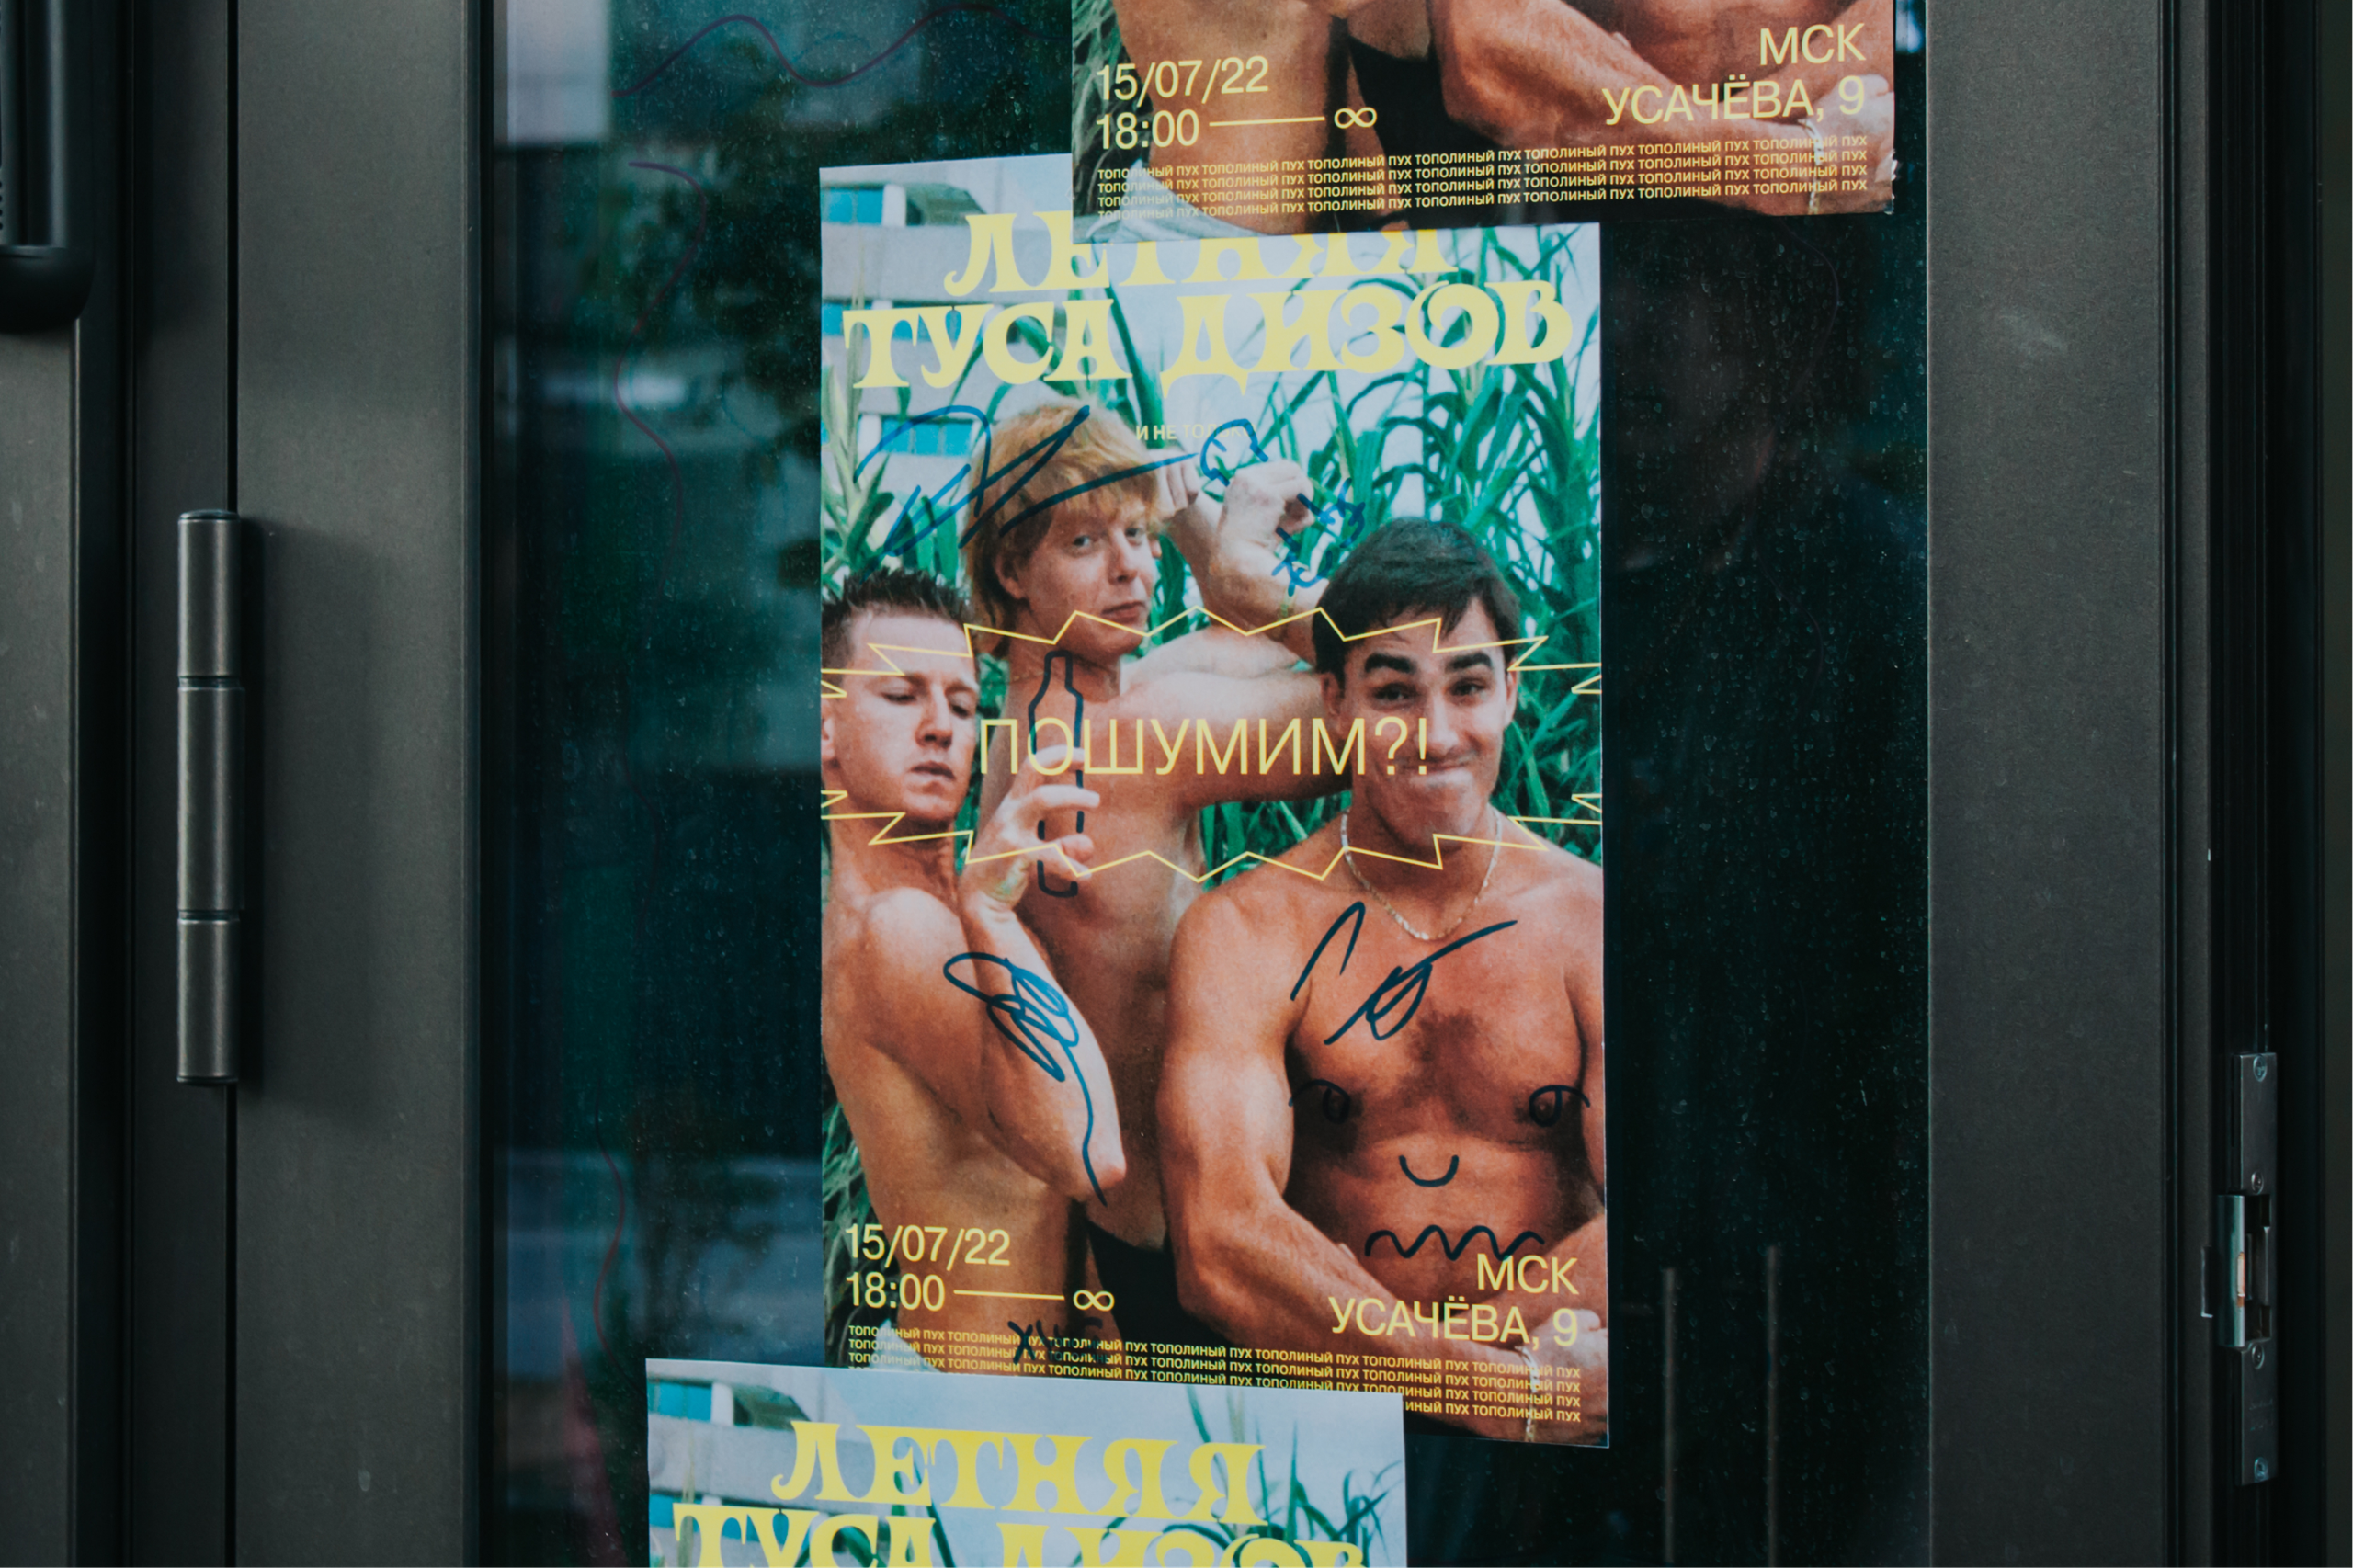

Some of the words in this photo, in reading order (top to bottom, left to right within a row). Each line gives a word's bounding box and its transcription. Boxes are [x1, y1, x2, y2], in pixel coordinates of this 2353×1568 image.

[1759, 22, 1867, 68] МСК
[1097, 56, 1269, 107] 15/07/22
[1600, 74, 1824, 126] УСАЧЁВА,
[1838, 74, 1866, 115] 9
[1097, 108, 1200, 150] 18:00
[1098, 165, 1173, 180] ТОПОЛИНЫЙ
[1176, 165, 1199, 176] ПУХ
[1202, 161, 1278, 176] ТОПОЛИНЫЙ
[1282, 160, 1304, 172] ПУХ
[1307, 156, 1384, 171] ТОПОЛИНЫЙ
[1389, 155, 1412, 167] ПУХ
[1415, 152, 1494, 166] ТОПОЛИНЫЙ
[1498, 151, 1521, 163] ПУХ
[1524, 146, 1607, 161] ТОПОЛИНЫЙ
[1610, 145, 1634, 157] ПУХ
[1638, 142, 1721, 156] ТОПОЛИНЫЙ
[1725, 141, 1749, 152] ПУХ
[1842, 135, 1867, 147] ПУХ
[1098, 179, 1173, 194] ТОПОЛИНЫЙ
[1176, 178, 1199, 190] ПУХ
[1202, 175, 1278, 189] ТОПОЛИНЫЙ
[1282, 174, 1304, 186] ПУХ
[1307, 170, 1384, 185] ТОПОЛИНЫЙ
[1389, 169, 1412, 181] ПУХ
[1415, 165, 1494, 180] ТОПОЛИНЫЙ
[1498, 165, 1521, 176] ПУХ
[1524, 161, 1607, 176] ТОПОЛИНЫЙ
[1610, 160, 1634, 172] ПУХ
[1638, 156, 1721, 170] ТОПОЛИНЫЙ
[1725, 155, 1749, 166] ПУХ
[1842, 150, 1867, 162] ПУХ
[1176, 192, 1199, 204] ПУХ
[1202, 188, 1278, 203] ТОПОЛИНЫЙ
[1282, 188, 1304, 199] ПУХ
[1307, 185, 1384, 199] ТОПОЛИНЫЙ
[1389, 184, 1412, 195] ПУХ
[1415, 180, 1494, 194] ТОПОЛИНЫЙ
[1498, 179, 1521, 190] ПУХ
[1524, 176, 1607, 189] ТОПОЛИНЫЙ
[1610, 175, 1634, 186] ПУХ
[1638, 170, 1721, 185] ТОПОЛИНЫЙ
[1725, 169, 1749, 181] ПУХ
[1754, 165, 1837, 180] ТОПОЛИНЫЙ
[1842, 165, 1867, 176] ПУХ
[1202, 203, 1278, 217] ТОПОЛИНЫЙ
[1282, 202, 1304, 213] ПУХ
[1307, 199, 1384, 212] ТОПОЛИНЫЙ
[1389, 198, 1412, 210] ПУХ
[1415, 194, 1494, 209] ТОПОЛИНЫЙ
[1498, 194, 1521, 205] ПУХ
[1524, 190, 1607, 204] ТОПОЛИНЫЙ
[1610, 189, 1634, 200] ПУХ
[1638, 186, 1721, 199] ТОПОЛИНЫЙ
[1725, 185, 1749, 196] ПУХ
[1754, 180, 1837, 195] ТОПОЛИНЫЙ
[1842, 179, 1867, 191] ПУХ
[844, 300, 1132, 388] ТУСА
[1160, 280, 1573, 398] ДИЗОВ
[1135, 425, 1149, 441] И
[1153, 424, 1177, 440] НЕ
[980, 716, 1427, 776] ПОШУМИМ?!
[845, 1224, 1011, 1271] 15/07/22
[847, 1271, 946, 1312] 18:00
[1475, 1252, 1580, 1295] МСК
[1328, 1295, 1540, 1351] УСАЧЁВА,
[1552, 1308, 1579, 1347] 9
[849, 1325, 920, 1340] ТОПОЛИНЫЙ
[924, 1330, 944, 1341] ПУХ
[948, 1331, 1019, 1346] ТОПОЛИНЫЙ
[1125, 1341, 1147, 1353] ПУХ
[1151, 1343, 1226, 1358] ТОПОЛИНЫЙ
[1230, 1347, 1251, 1359] ПУХ
[1256, 1348, 1332, 1364] ТОПОЛИНЫЙ
[1336, 1353, 1359, 1366] ПУХ
[1363, 1355, 1441, 1370] ТОПОЛИНЫЙ
[1446, 1359, 1469, 1372] ПУХ
[1557, 1366, 1580, 1379] ПУХ
[849, 1338, 920, 1354] ТОПОЛИНЫЙ
[924, 1343, 944, 1355] ПУХ
[948, 1345, 1019, 1359] ТОПОЛИНЫЙ
[1125, 1355, 1147, 1368] ПУХ
[1151, 1357, 1226, 1372] ТОПОЛИНЫЙ
[1230, 1361, 1251, 1373] ПУХ
[1256, 1363, 1332, 1379] ТОПОЛИНЫЙ
[1336, 1368, 1359, 1380] ПУХ
[1363, 1369, 1441, 1385] ТОПОЛИНЫЙ
[1446, 1374, 1469, 1387] ПУХ
[1557, 1381, 1580, 1393] ПУХ
[924, 1357, 944, 1369] ПУХ
[948, 1358, 1019, 1373] ТОПОЛИНЫЙ
[1024, 1362, 1045, 1375] ПУХ
[1049, 1364, 1121, 1380] ТОПОЛИНЫЙ
[1125, 1369, 1147, 1381] ПУХ
[1151, 1370, 1226, 1386] ТОПОЛИНЫЙ
[1230, 1375, 1251, 1388] ПУХ
[1256, 1377, 1332, 1390] ТОПОЛИНЫЙ
[1336, 1382, 1359, 1392] ПУХ
[1446, 1389, 1469, 1401] ПУХ
[1472, 1391, 1552, 1406] ТОПОЛИНЫЙ
[1557, 1395, 1580, 1408] ПУХ
[1446, 1403, 1469, 1415] ПУХ
[1472, 1405, 1552, 1421] ТОПОЛИНЫЙ
[1557, 1410, 1580, 1423] ПУХ
[770, 1420, 1267, 1527] ЛЕТНЯЯ
